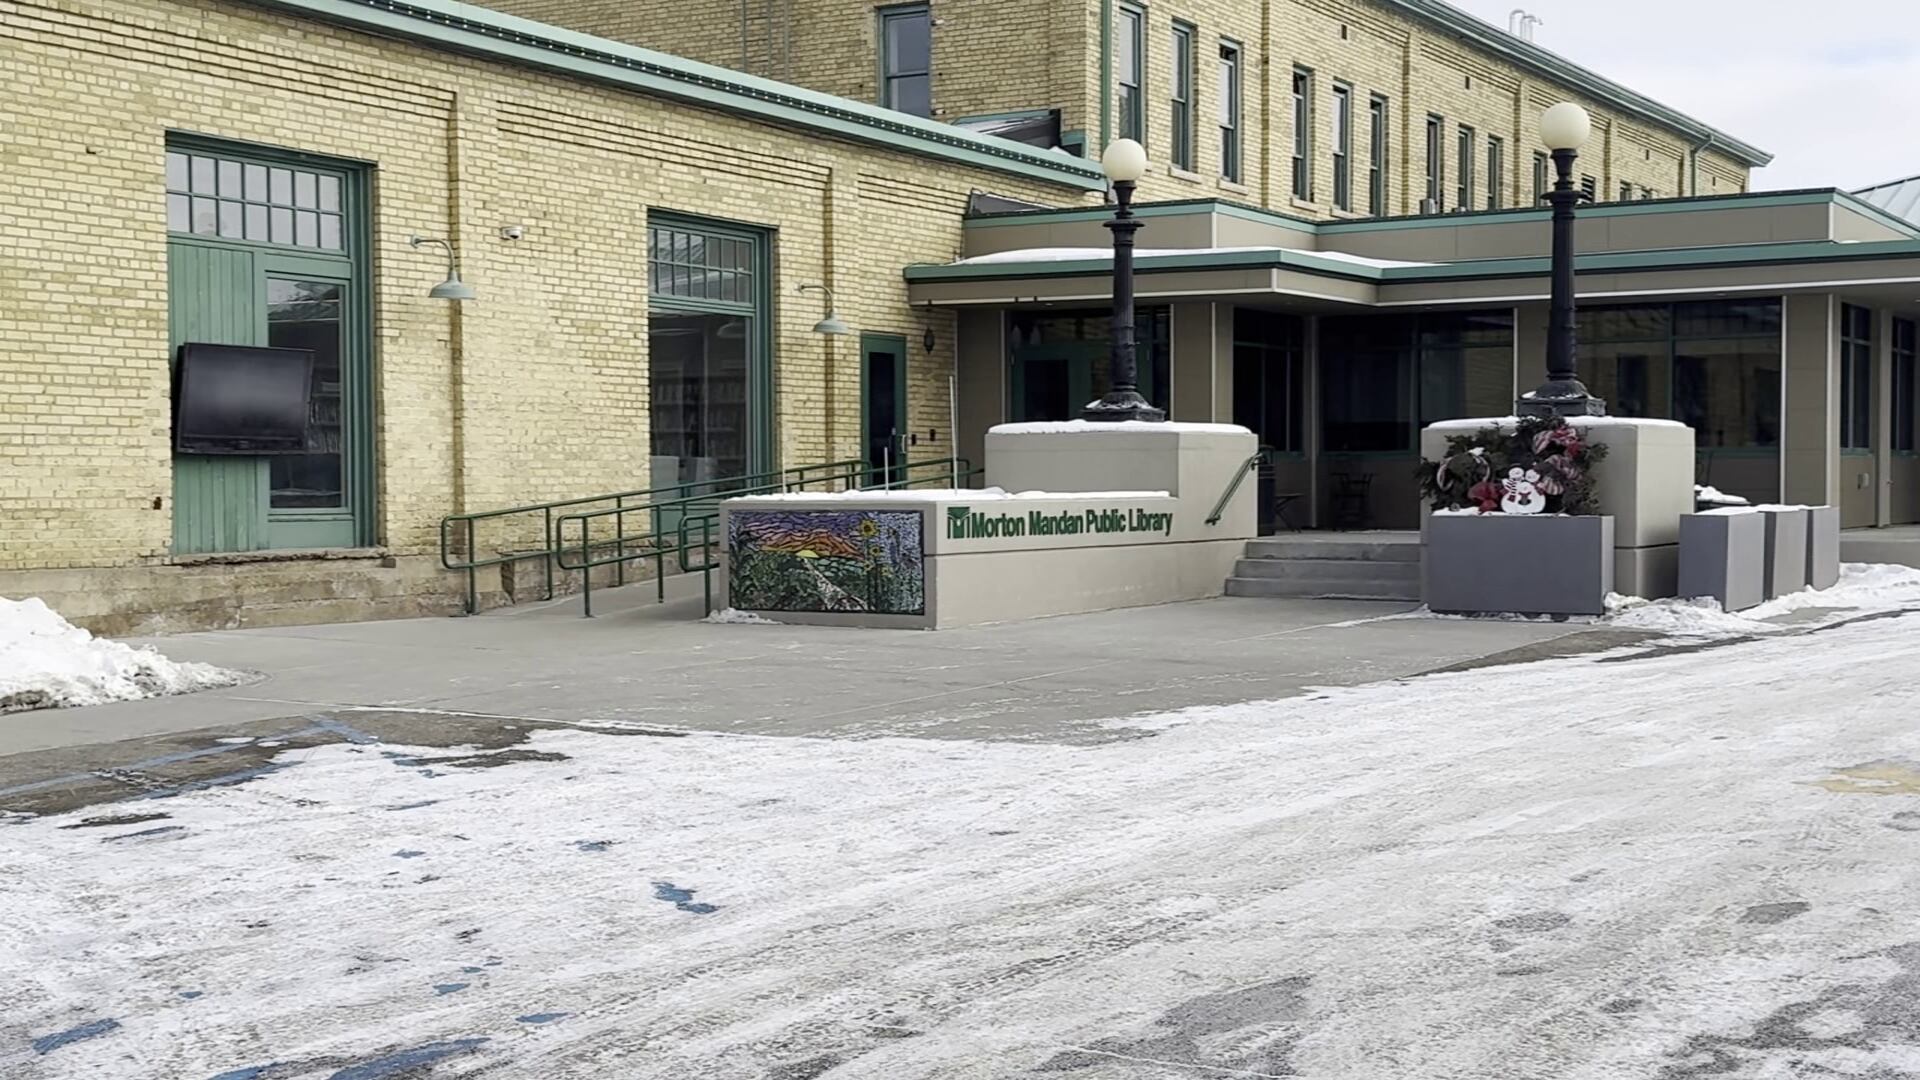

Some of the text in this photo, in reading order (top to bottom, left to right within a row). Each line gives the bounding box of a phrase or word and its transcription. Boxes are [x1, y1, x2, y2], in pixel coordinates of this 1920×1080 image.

[971, 508, 1173, 538] Morton Mandan Public Library
